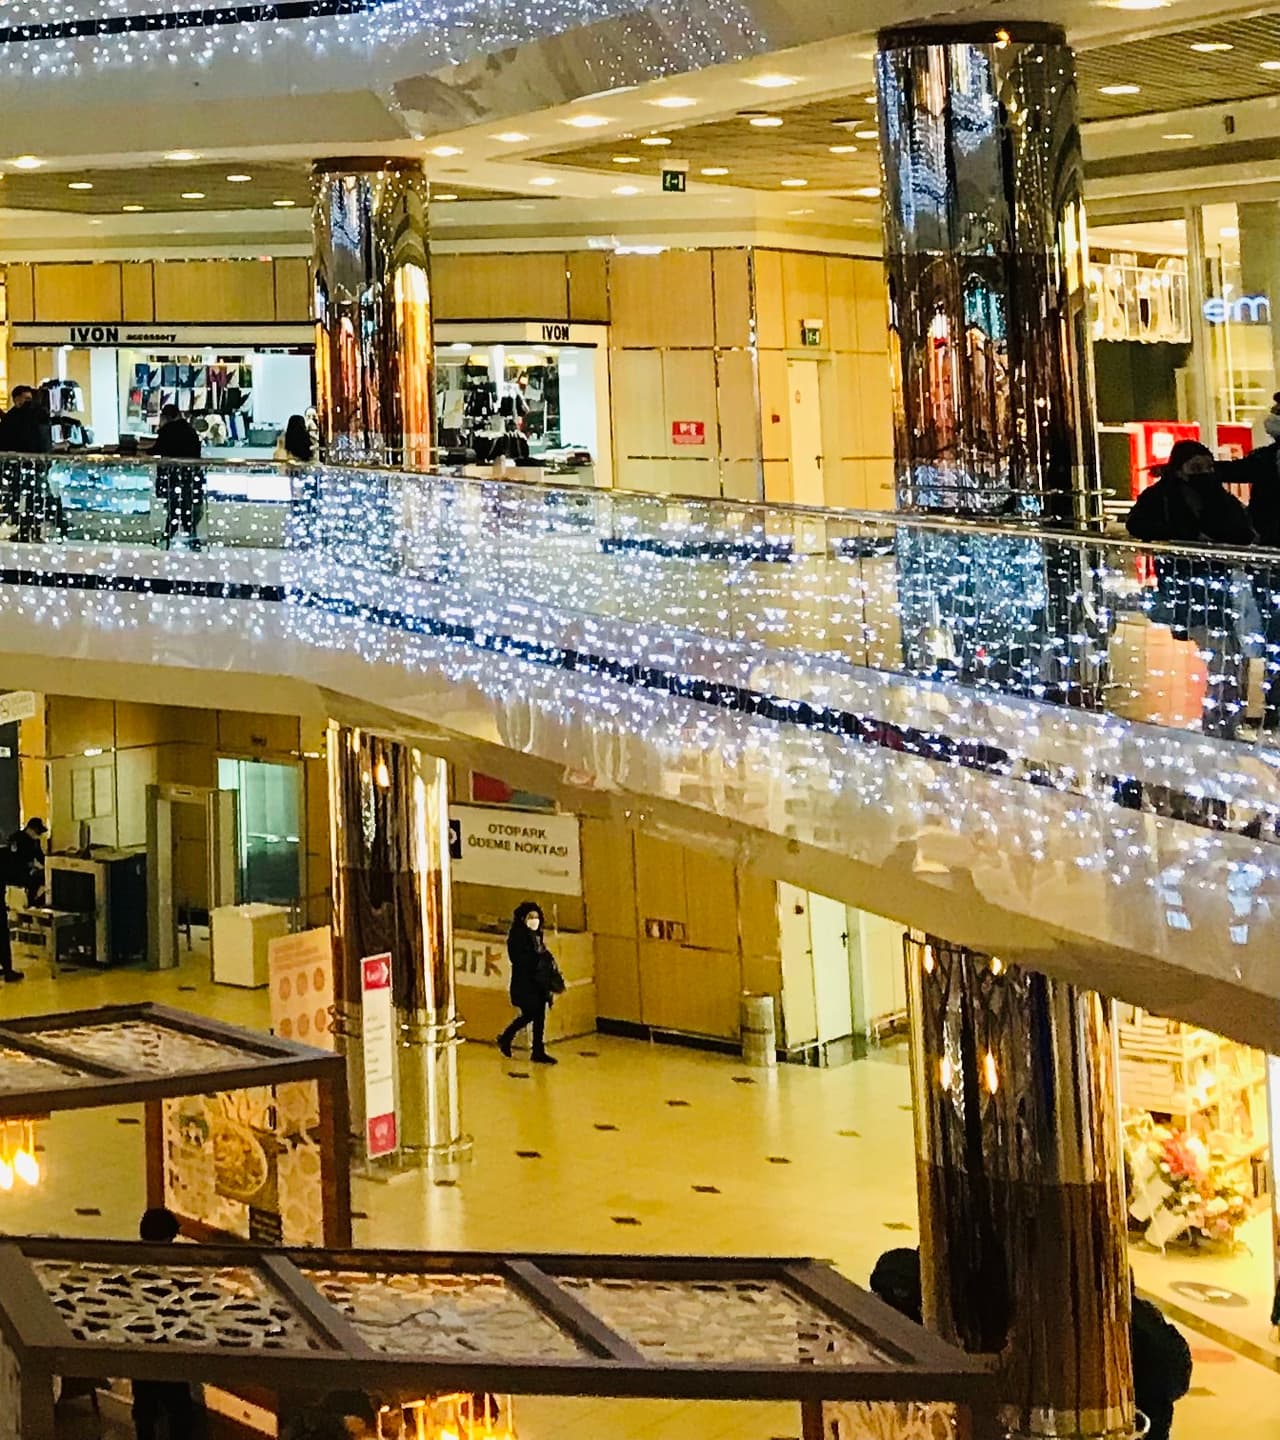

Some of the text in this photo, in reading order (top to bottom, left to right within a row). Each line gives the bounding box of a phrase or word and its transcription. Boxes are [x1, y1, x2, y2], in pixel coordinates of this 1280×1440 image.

[69, 327, 119, 342] IVON
[542, 324, 569, 341] IVON
[487, 823, 547, 840] OTOPARK
[467, 834, 569, 858] ÖDEME NOKTASI
[453, 945, 503, 978] ark
